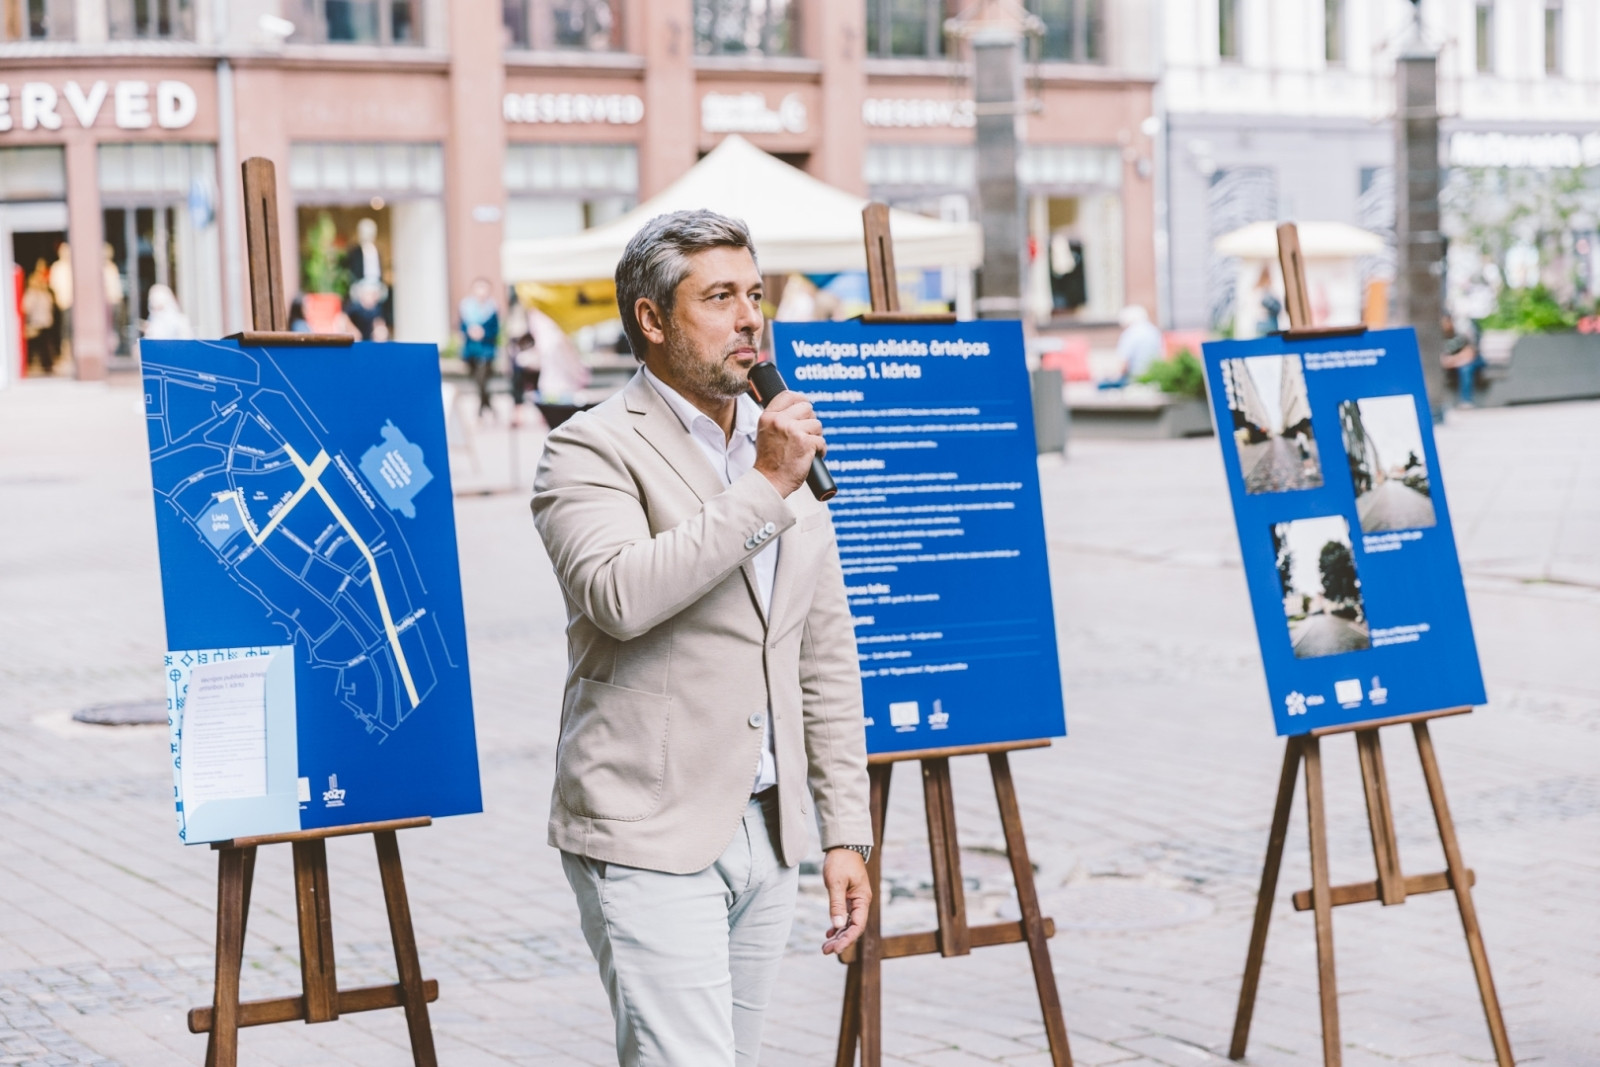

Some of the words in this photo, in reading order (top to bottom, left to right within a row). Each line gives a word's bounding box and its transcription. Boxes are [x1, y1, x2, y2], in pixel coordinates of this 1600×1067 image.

[503, 92, 644, 124] RESERVED
[868, 362, 880, 379] 1.
[881, 362, 922, 379] kārta
[322, 788, 346, 801] 2027
